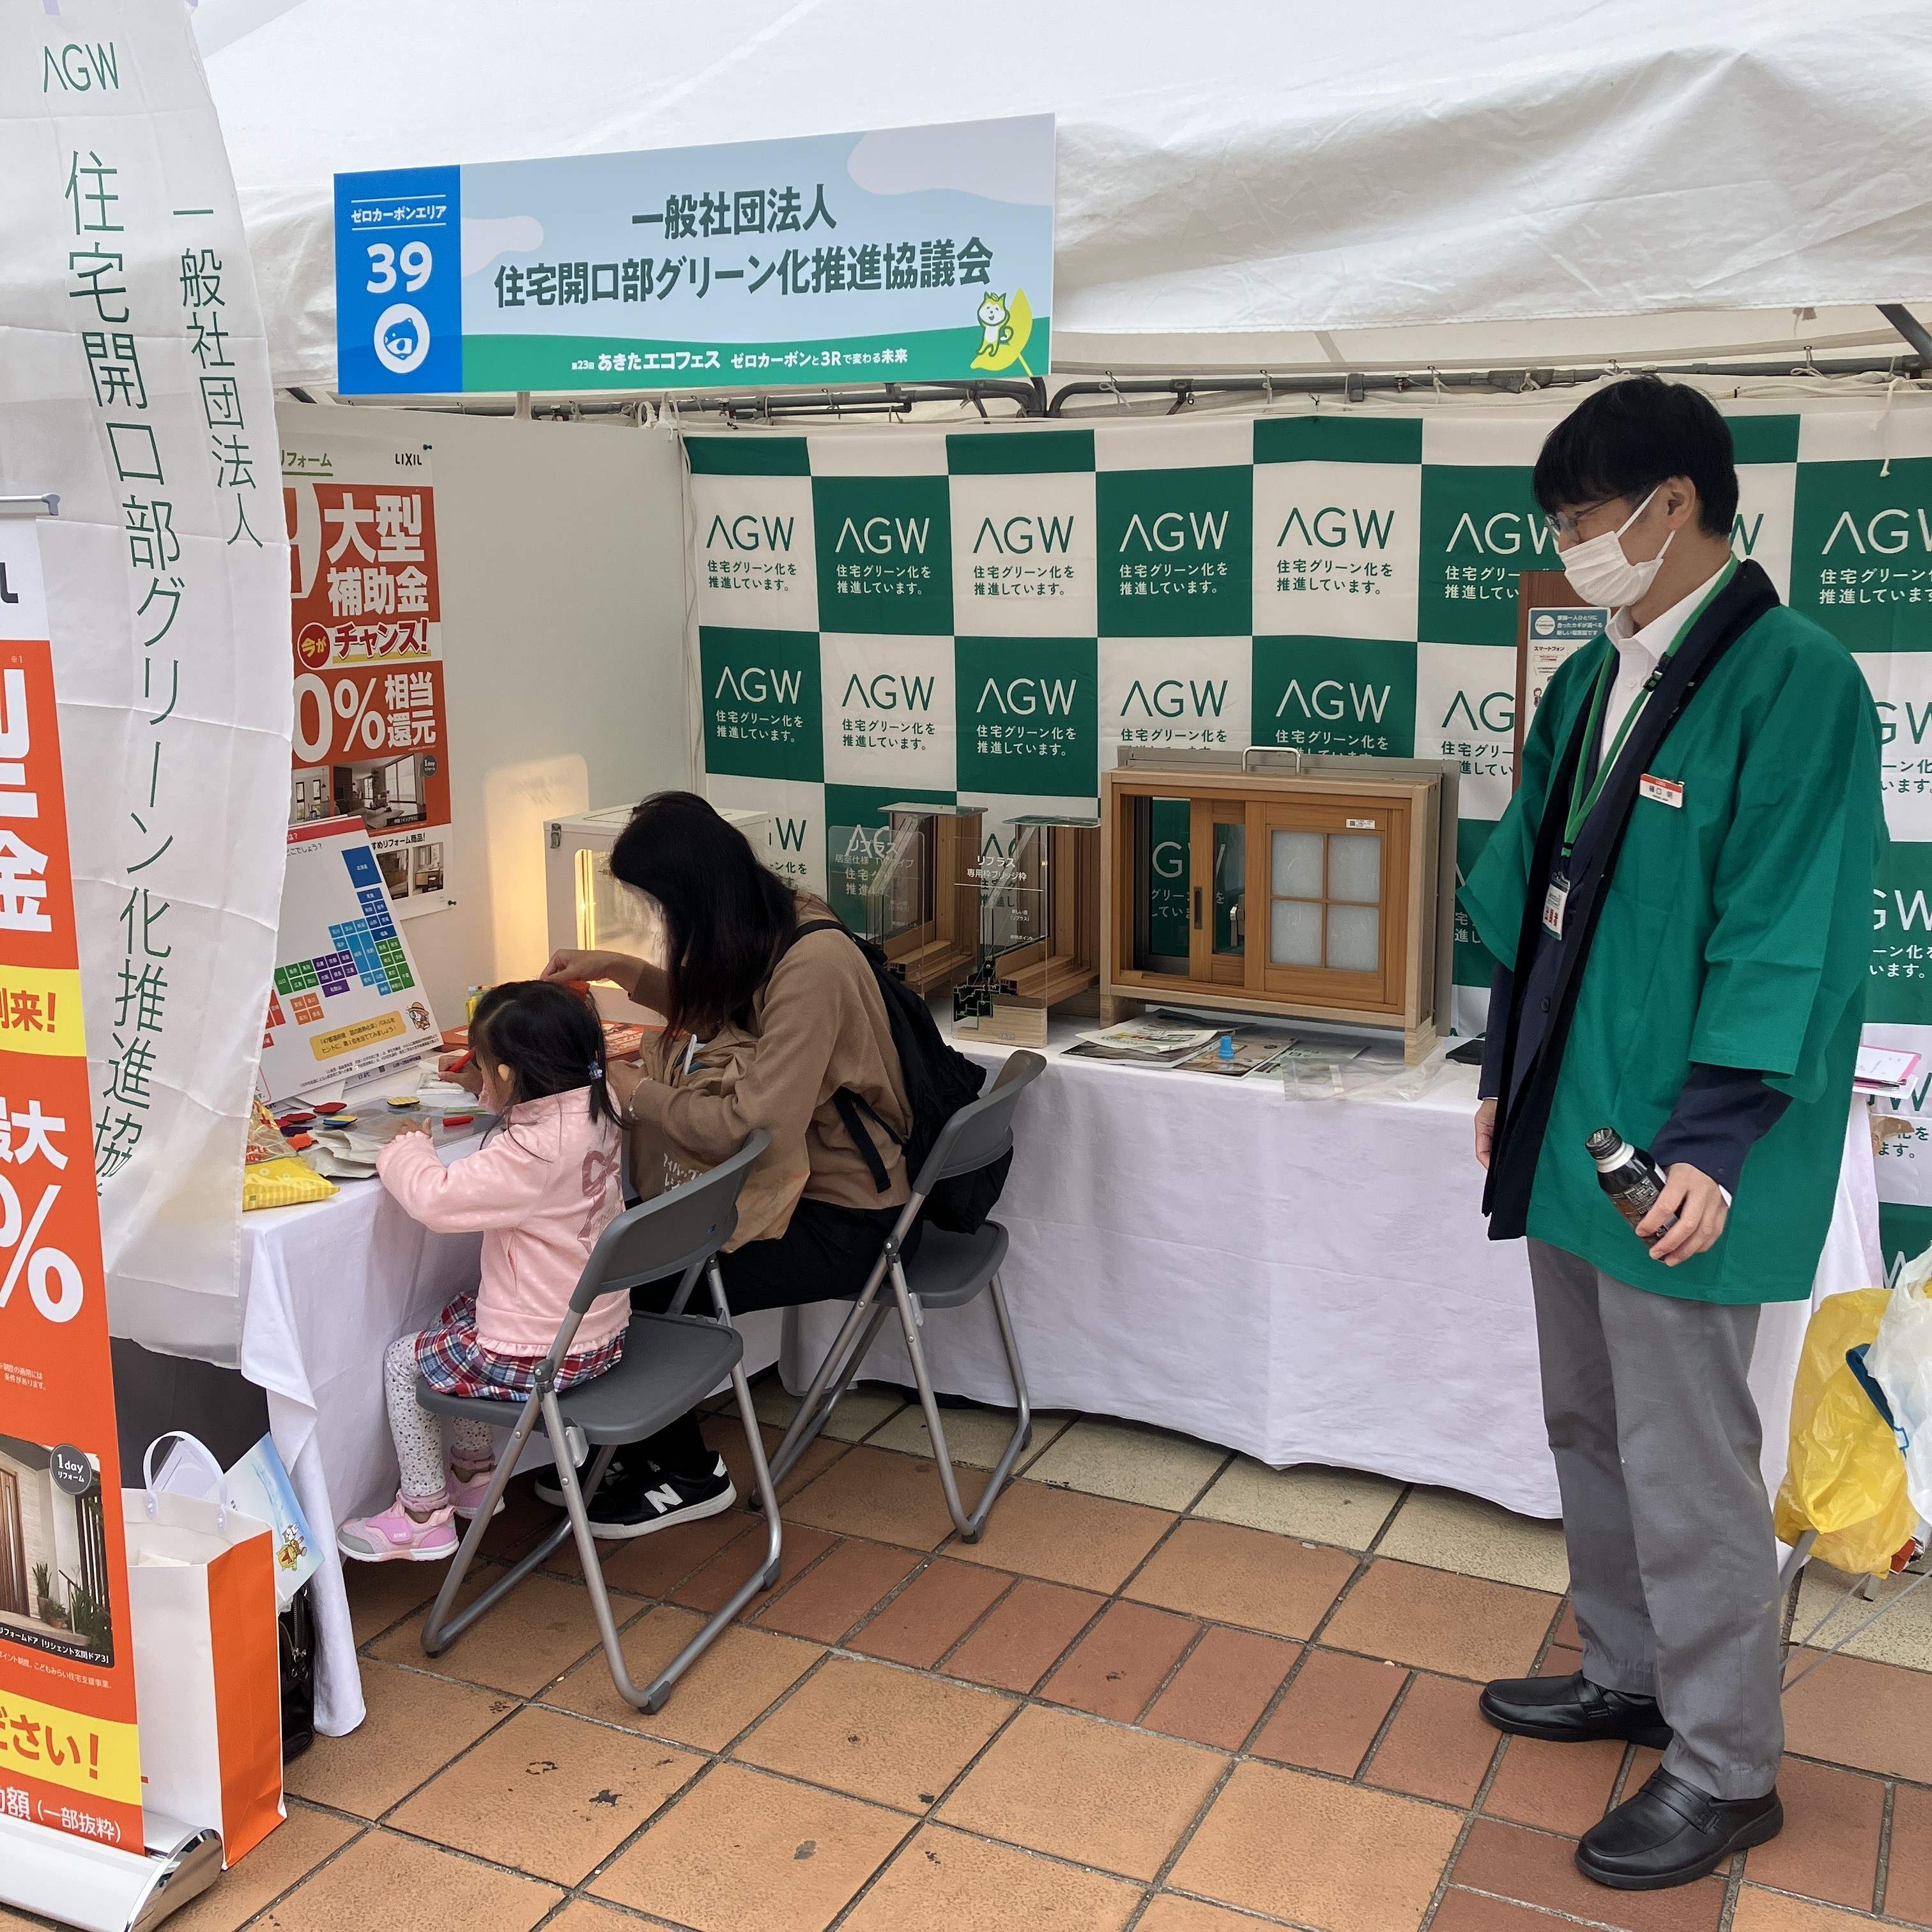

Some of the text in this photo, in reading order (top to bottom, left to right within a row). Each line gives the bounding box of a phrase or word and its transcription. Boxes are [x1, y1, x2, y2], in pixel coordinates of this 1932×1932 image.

[43, 42, 120, 93] AGW
[351, 204, 448, 223] ゼロカーボンエリア
[632, 184, 837, 240] 一般社団法人
[365, 243, 433, 294] 39
[494, 236, 994, 308] 住宅開口部グリーン化推進協議会
[598, 351, 721, 372] あきたエコフェス
[173, 209, 263, 548] 一般社団法人
[395, 452, 422, 466] LIXIL
[324, 492, 425, 564] 大型
[706, 514, 794, 551] AGW
[836, 517, 930, 554] AGW
[973, 516, 1074, 554] AGW
[1119, 510, 1229, 552] AGW
[1276, 507, 1394, 549] AGW
[707, 560, 797, 576] 住宅グリーン化を
[836, 564, 931, 579] 住宅グリーン化を
[973, 565, 1075, 579] 住宅グリーン化を
[1119, 561, 1229, 578] 住宅グリーン化を
[1276, 559, 1393, 577] 住宅グリーン化を
[326, 565, 429, 617] 補助金
[709, 576, 789, 592] 推進しています。
[836, 581, 923, 595] 推進しています。
[974, 581, 1065, 595] 推進しています。
[1119, 579, 1216, 595] 推進しています。
[1276, 577, 1380, 595] 推進しています。
[65, 151, 185, 1196] 住宅開口部グリーン化推進協
[385, 671, 434, 711] 相当
[715, 666, 802, 703] AGW
[841, 673, 935, 710] AGW
[976, 678, 1077, 715] AGW
[1120, 680, 1228, 717] AGW
[1276, 679, 1390, 723] AGW
[387, 709, 436, 749] 還元
[716, 710, 803, 728] 住宅グリーン化を
[841, 719, 935, 735] 住宅グリーン化を
[716, 724, 795, 742] 推進しています。
[842, 734, 926, 751] 推進しています。
[976, 724, 1077, 740] 住宅グリーン化を
[1121, 728, 1227, 742] 住宅グリーン化を
[1275, 729, 1388, 750] 住宅グリーン化を
[977, 740, 1066, 756] 推進しています。
[769, 862, 807, 875] ン化を
[57, 1453, 84, 1473] 1day
[57, 1471, 85, 1483] リフォーム
[645, 1483, 683, 1514] N
